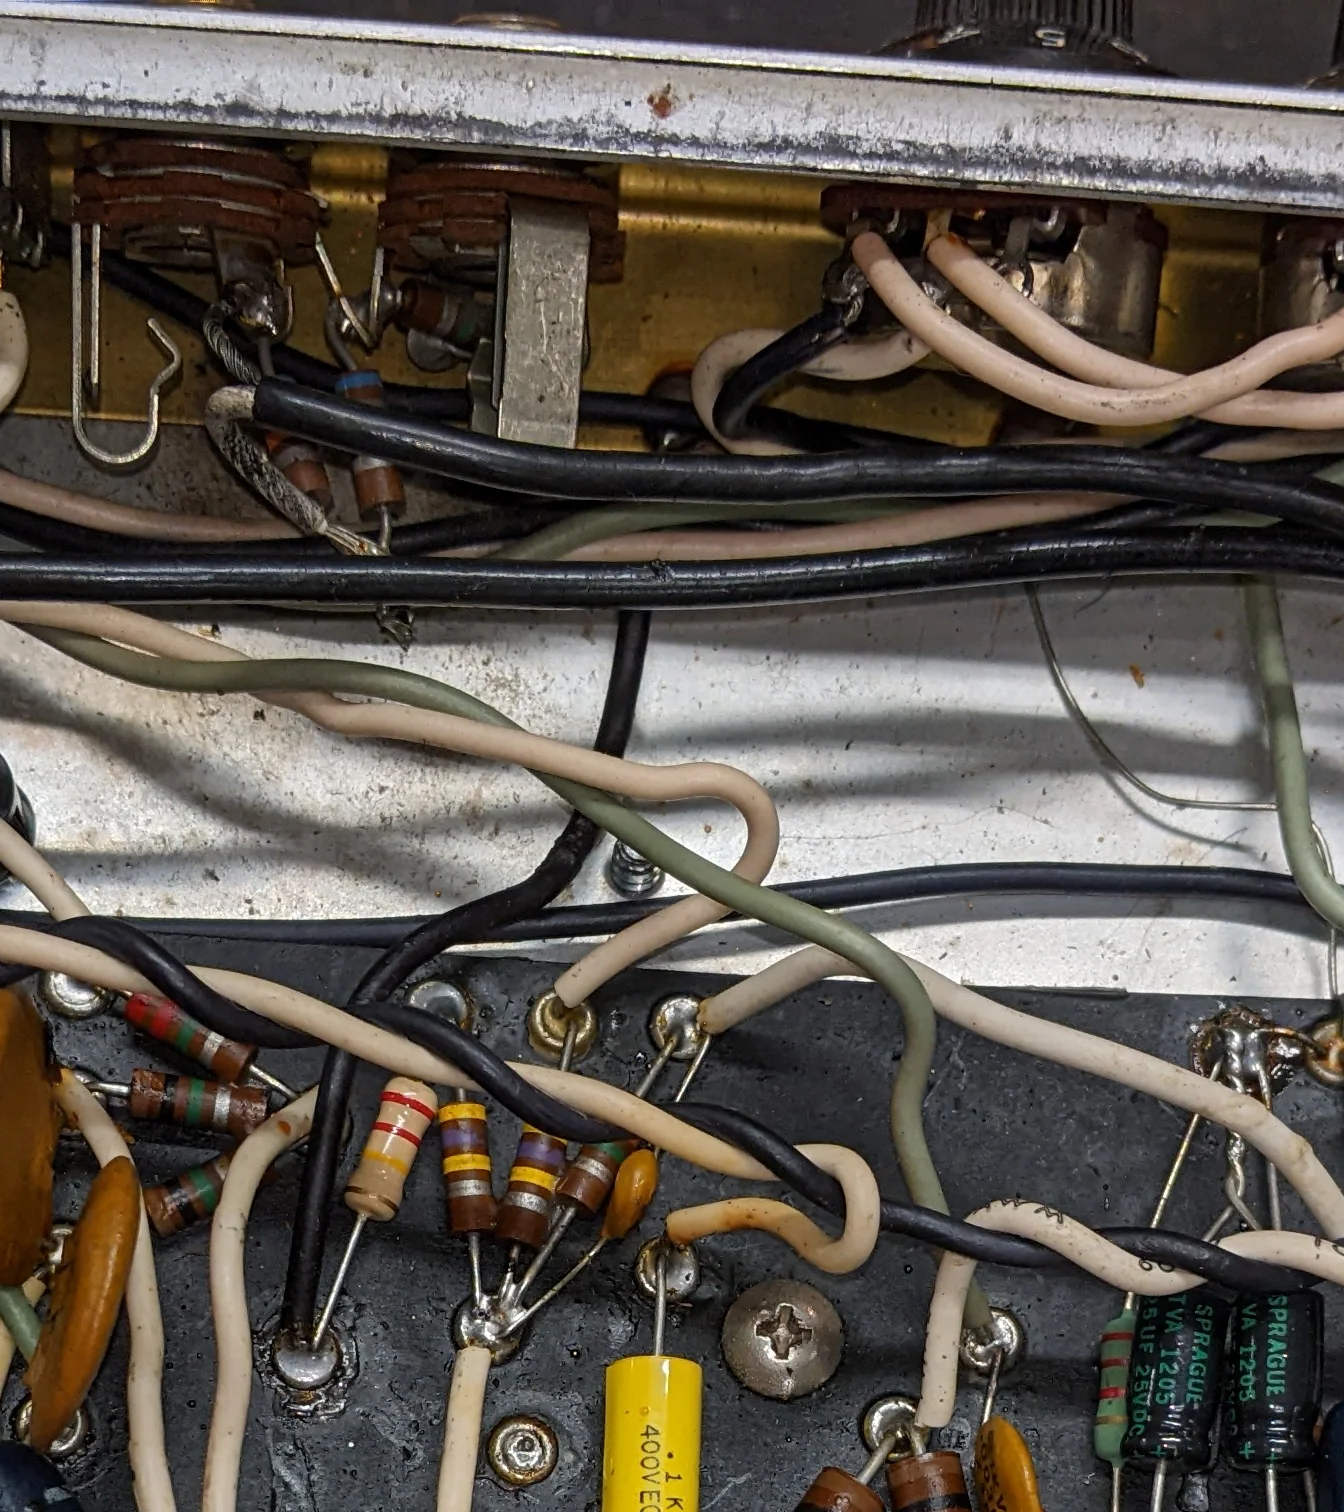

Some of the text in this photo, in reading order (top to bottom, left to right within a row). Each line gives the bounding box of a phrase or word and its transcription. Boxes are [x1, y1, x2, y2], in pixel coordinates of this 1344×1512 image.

[1186, 1303, 1215, 1405] SPRAGUE
[1241, 1303, 1257, 1331] VA
[1266, 1294, 1289, 1397] SPRAGUE
